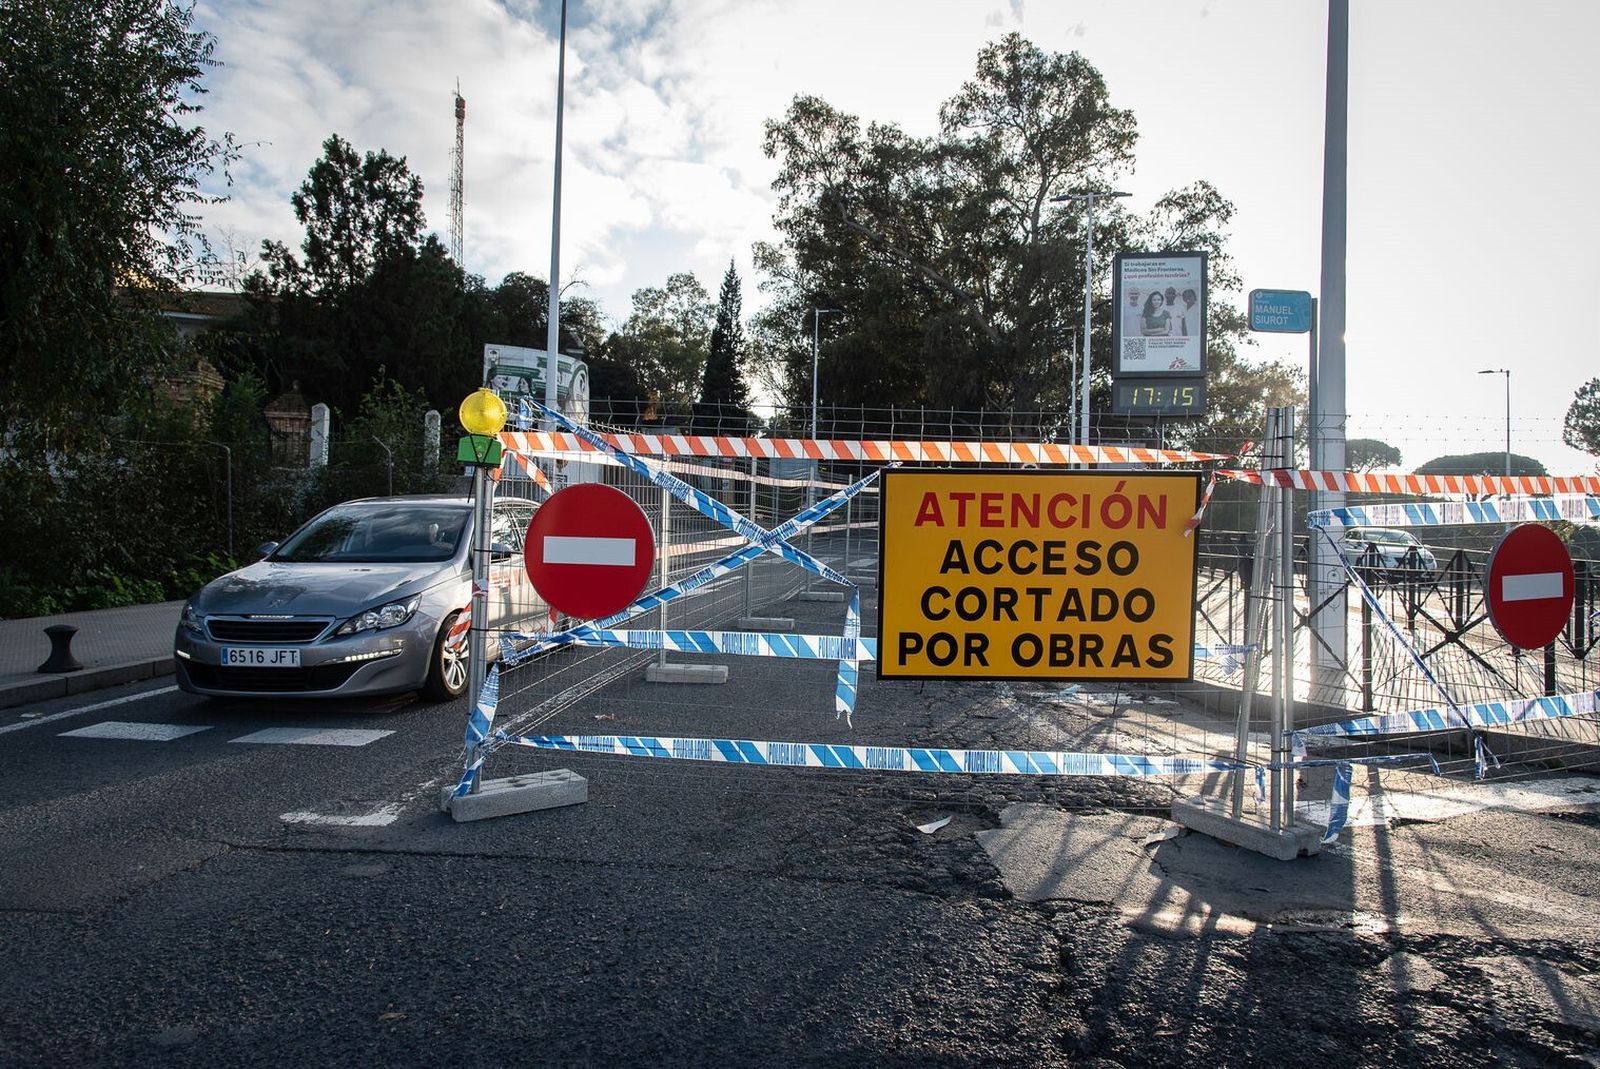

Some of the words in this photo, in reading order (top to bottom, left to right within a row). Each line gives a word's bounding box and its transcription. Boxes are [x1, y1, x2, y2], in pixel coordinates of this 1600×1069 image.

[1255, 304, 1294, 315] MANUEL
[1255, 314, 1289, 325] SIUROT
[1132, 387, 1193, 406] 17:15
[914, 480, 1167, 529] ATENCIÓN
[939, 539, 1140, 576] ACCESO
[920, 585, 1155, 623] CORTADO
[229, 649, 264, 664] 6516
[270, 650, 297, 664] JFT
[898, 631, 989, 667] POR
[1011, 632, 1175, 669] OBRAS
